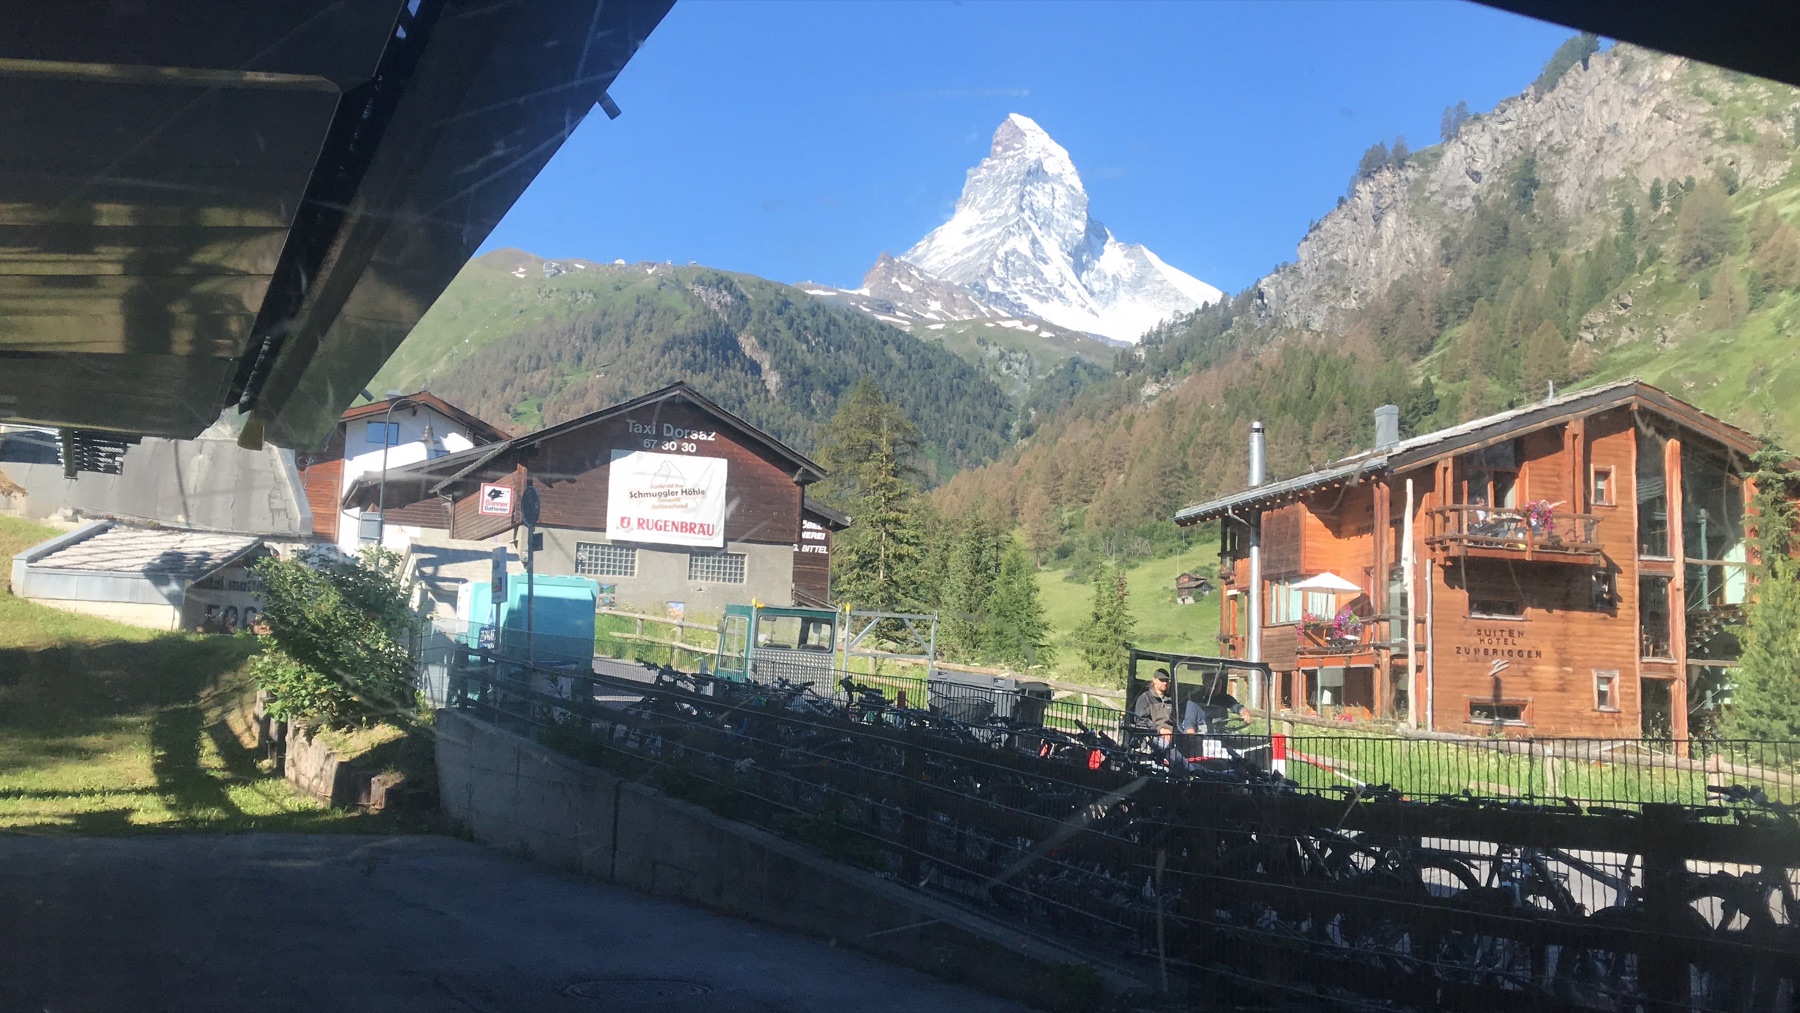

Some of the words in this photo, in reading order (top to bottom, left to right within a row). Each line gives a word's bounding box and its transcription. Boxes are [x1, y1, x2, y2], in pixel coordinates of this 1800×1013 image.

[626, 420, 656, 435] Taxi
[663, 423, 716, 441] Dorsaz
[643, 438, 657, 449] 67
[661, 440, 677, 451] 30
[681, 442, 697, 453] 30
[629, 489, 678, 499] Schmuggler
[680, 488, 706, 496] Höhle
[637, 517, 715, 536] RUGENBRÄU
[801, 545, 828, 554] BITTEL
[1476, 628, 1524, 638] SUITEN
[1479, 638, 1517, 646] HOTEL
[1455, 646, 1542, 659] ZURBRIGGEN
